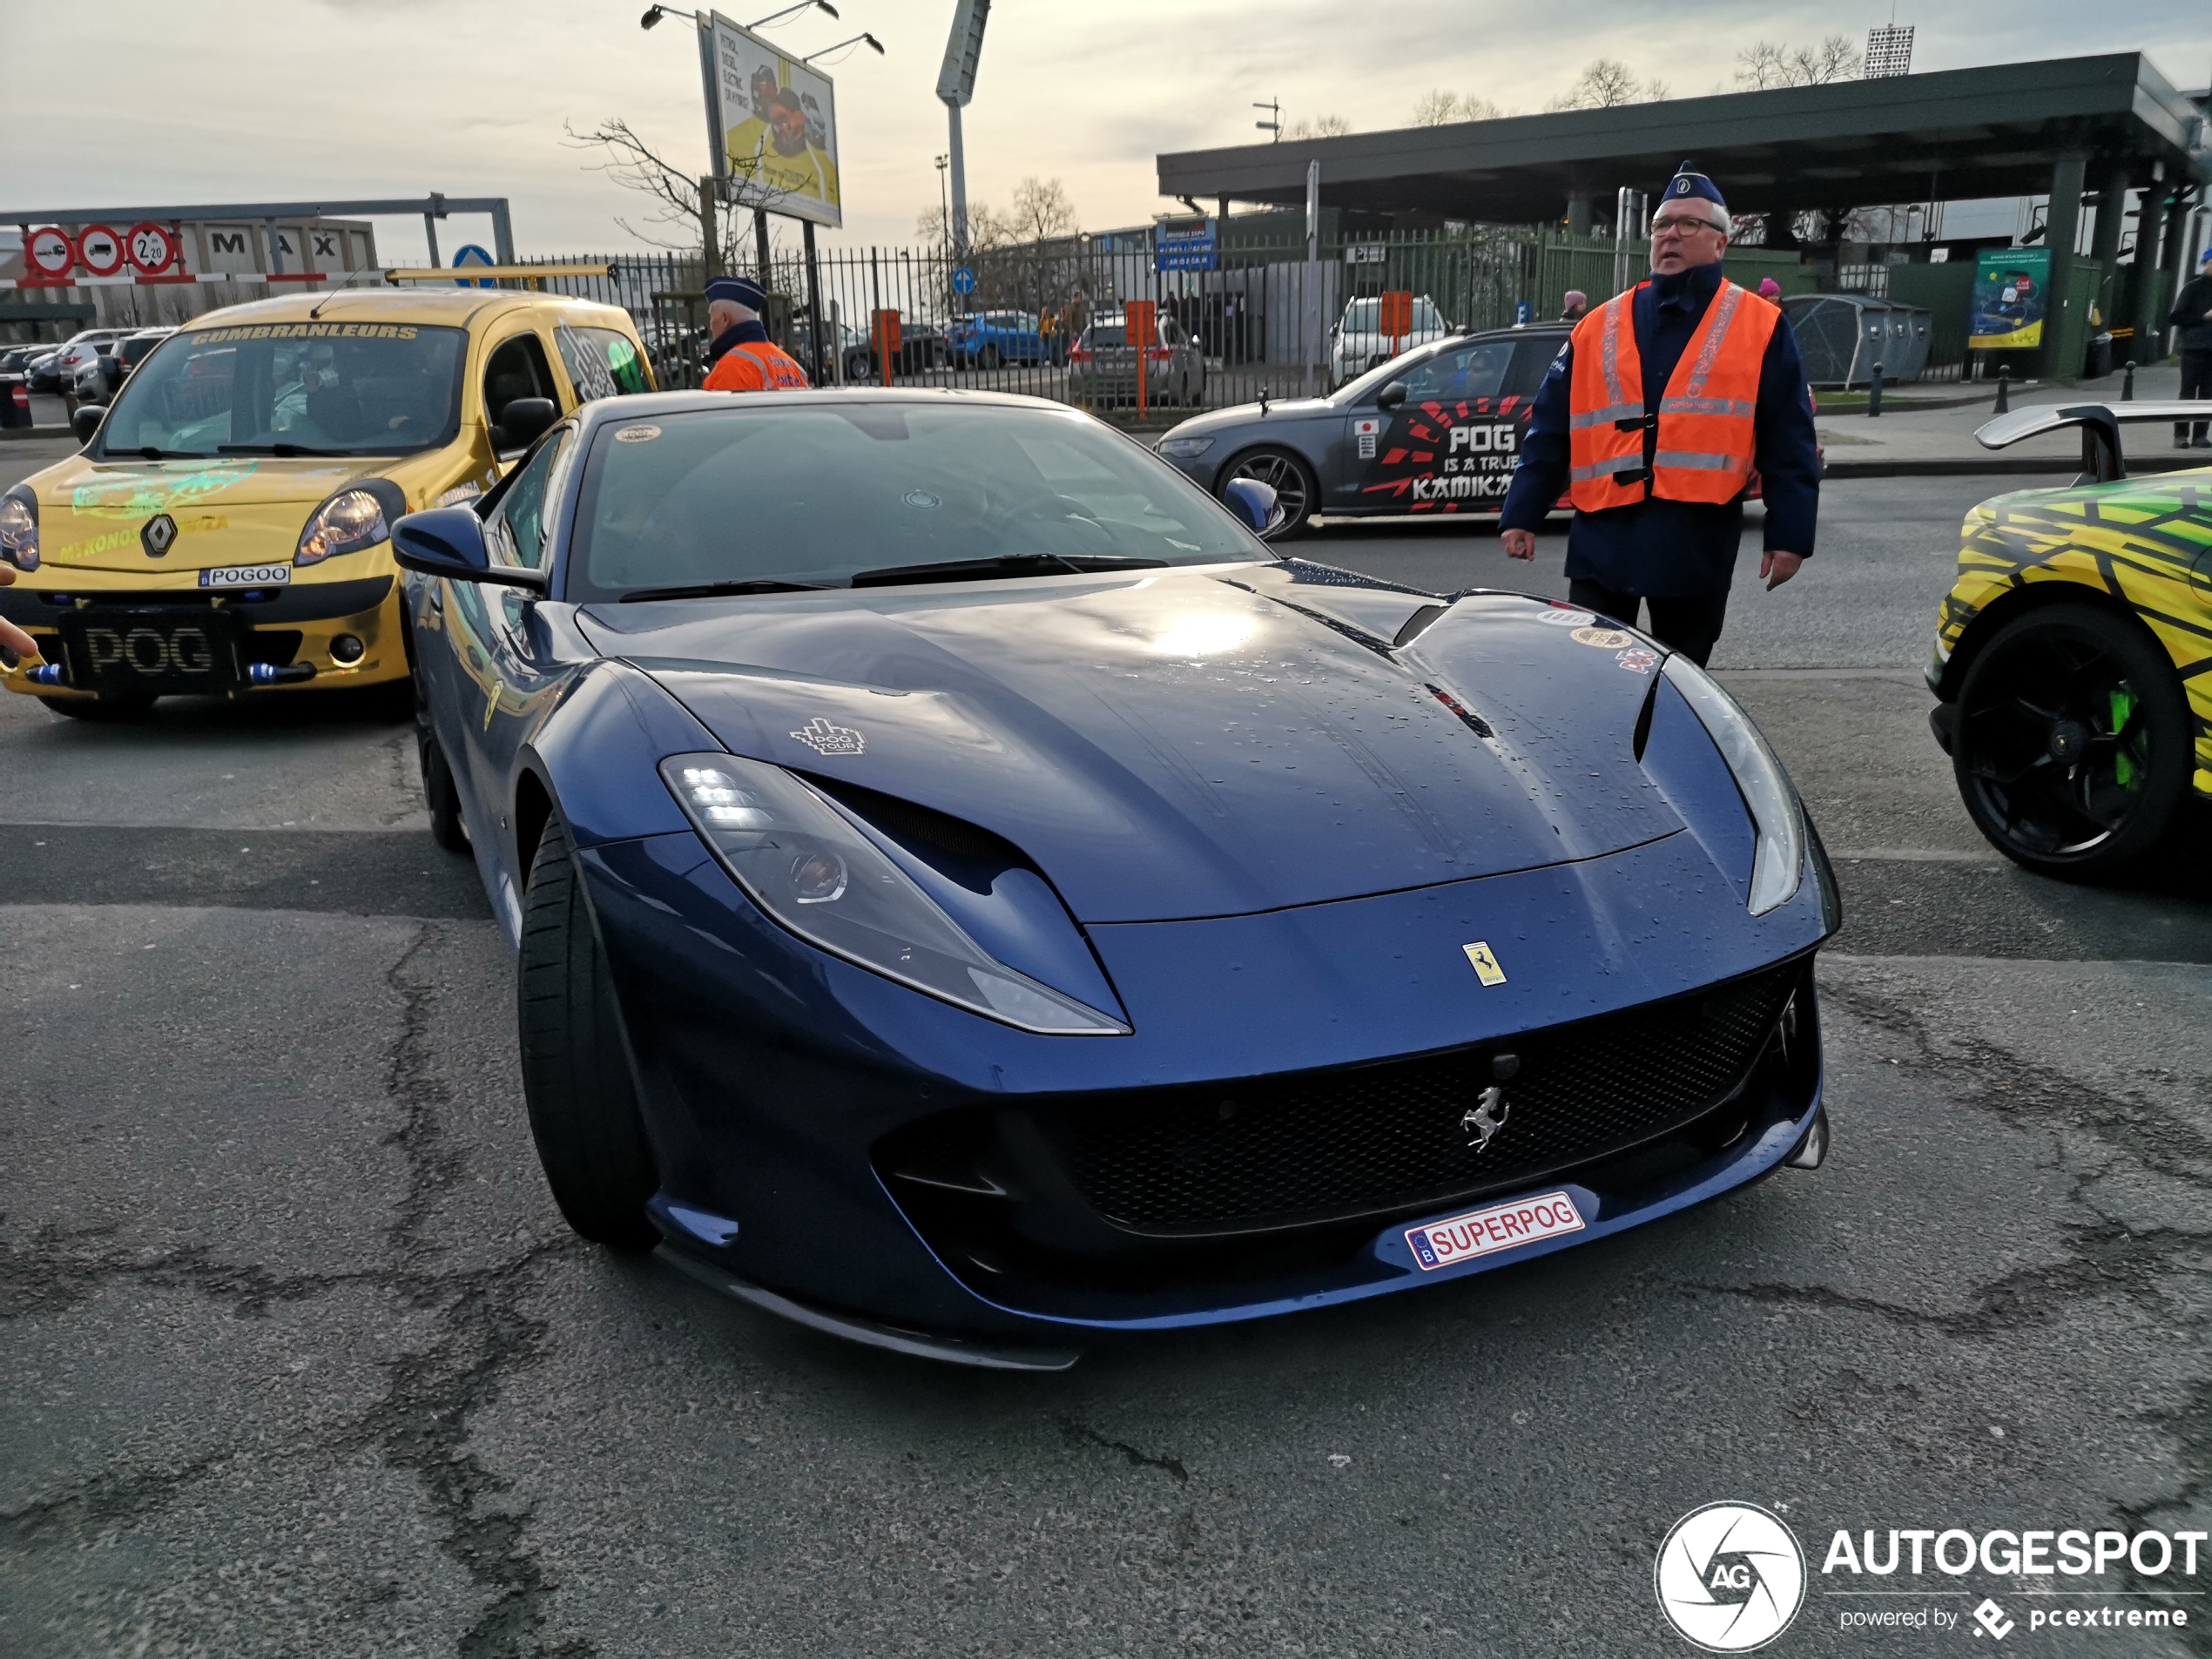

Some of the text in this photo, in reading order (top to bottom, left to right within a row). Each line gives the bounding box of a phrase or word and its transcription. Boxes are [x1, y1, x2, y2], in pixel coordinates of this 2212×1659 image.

[191, 324, 417, 346] GUMBRANLEURS
[1449, 424, 1515, 453] POG
[1444, 455, 1521, 472] IS A TRUE
[85, 628, 212, 673] POG
[814, 735, 852, 744] POG
[1421, 1201, 1575, 1263] B SUPERPOG
